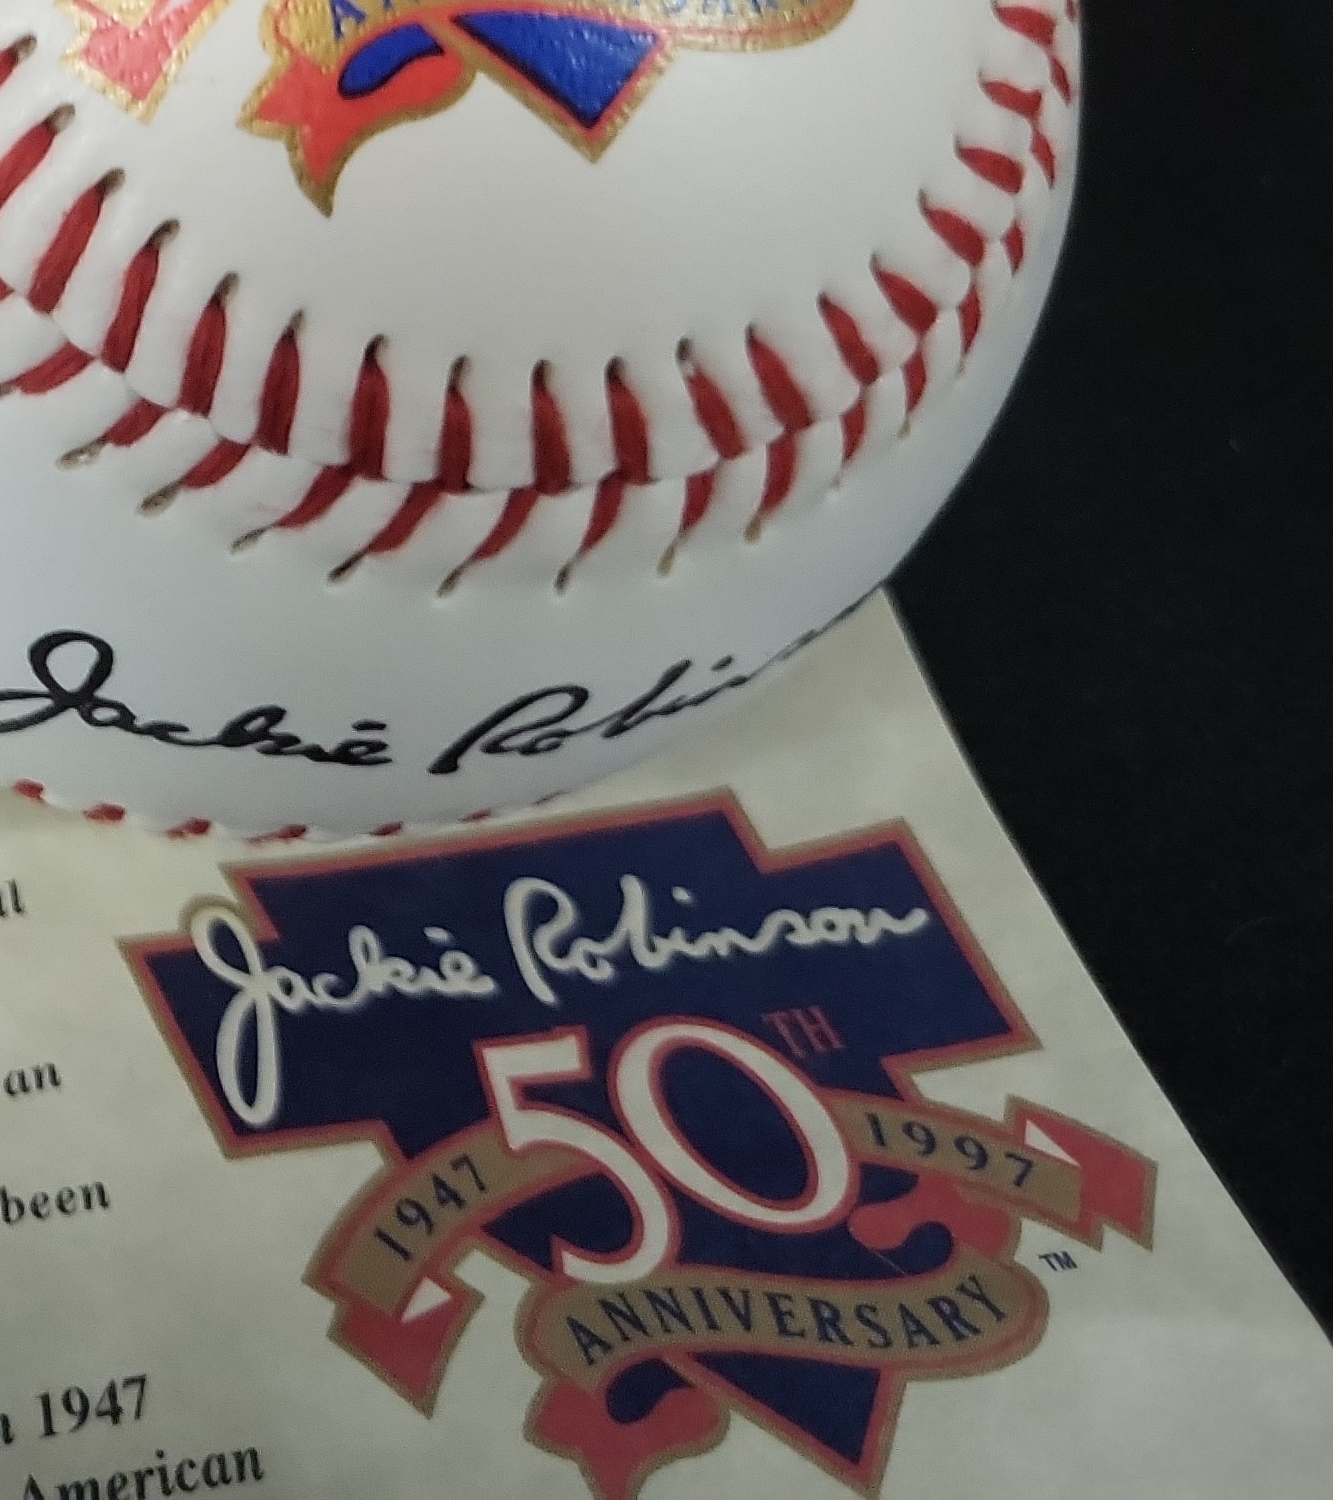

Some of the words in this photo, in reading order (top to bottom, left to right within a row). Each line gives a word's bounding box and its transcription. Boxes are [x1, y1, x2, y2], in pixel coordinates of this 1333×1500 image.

[190, 903, 497, 1128] Jackie
[504, 873, 932, 1003] Robinson
[2, 1061, 63, 1097] an
[866, 1113, 1036, 1188] 1997
[0, 1178, 111, 1226] been
[373, 1153, 489, 1263] 1947
[564, 1274, 1014, 1366] ANNIVERSARY
[37, 1374, 148, 1438] 1947
[23, 1447, 265, 1500] American
